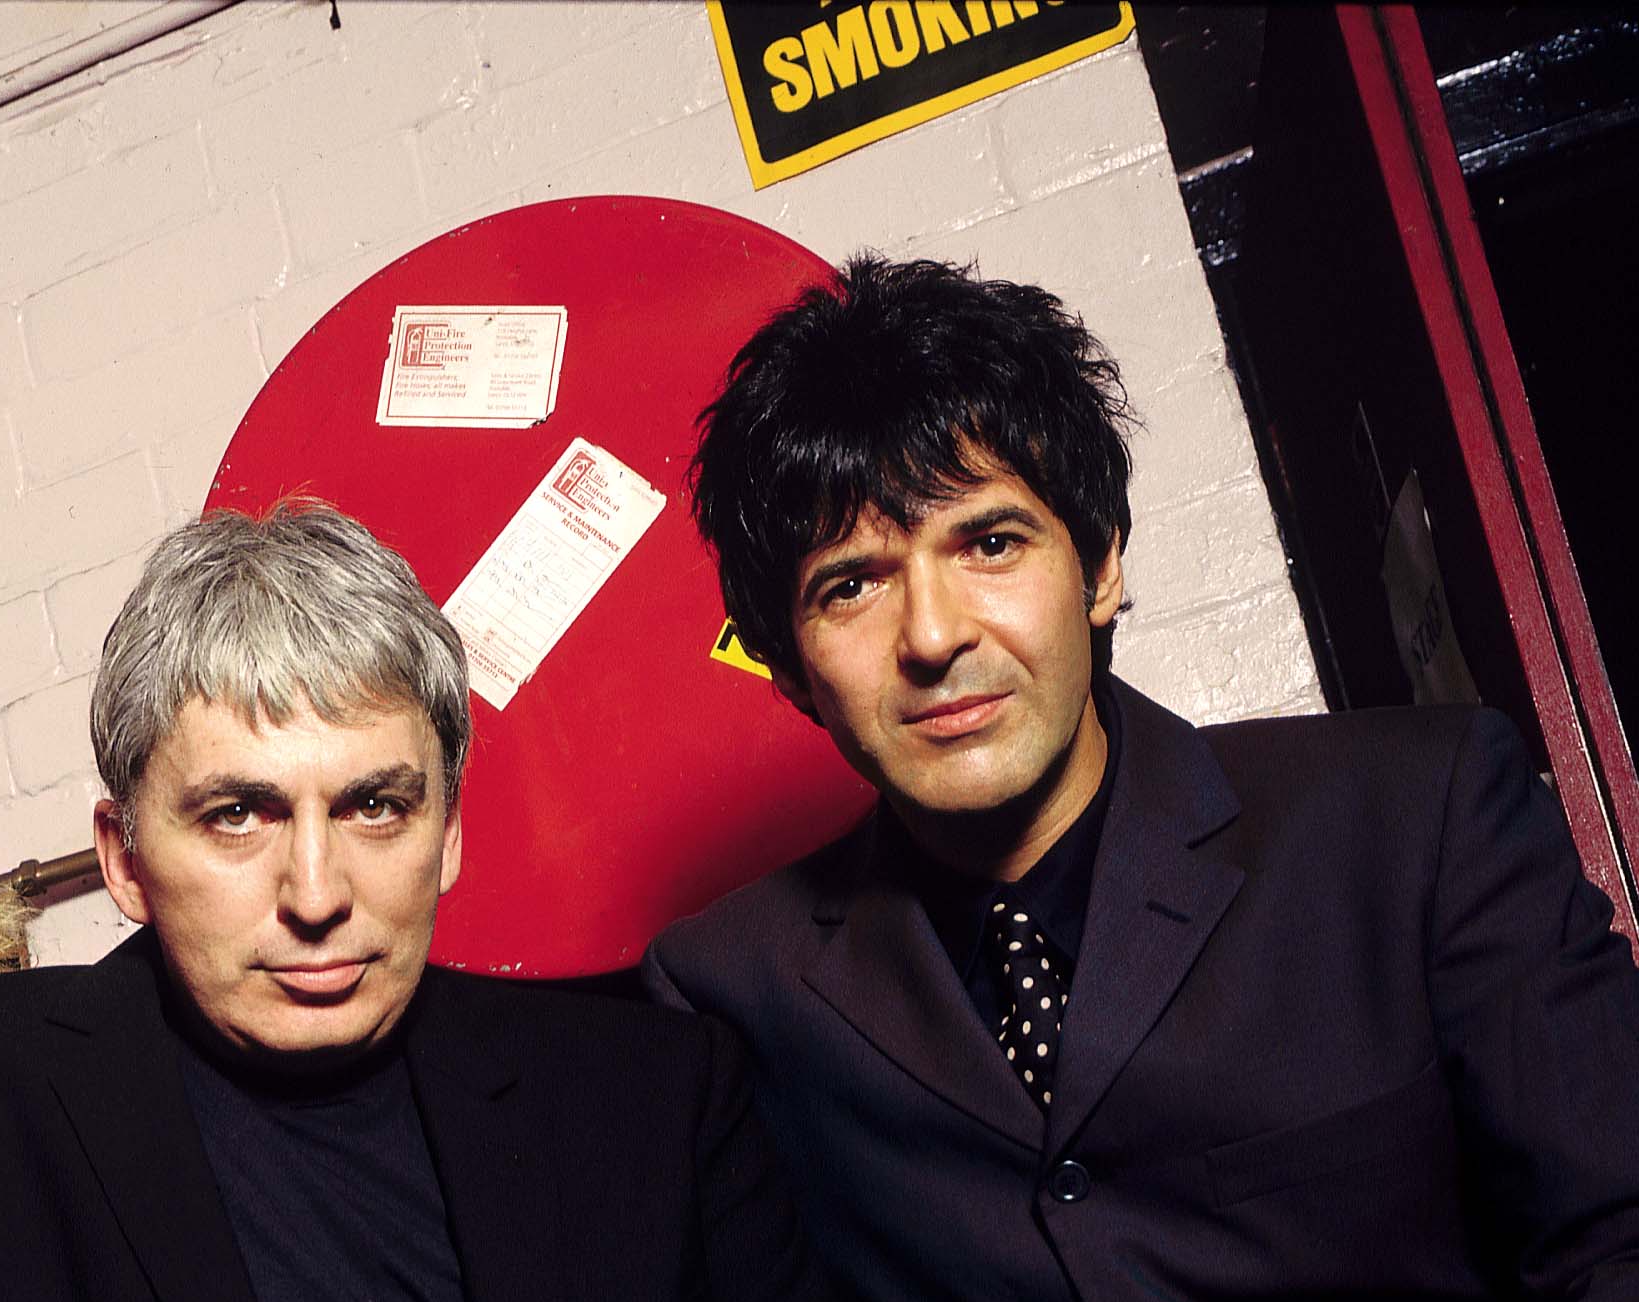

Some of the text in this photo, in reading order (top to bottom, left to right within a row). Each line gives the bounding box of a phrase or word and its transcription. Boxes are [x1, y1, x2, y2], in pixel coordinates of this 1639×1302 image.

[762, 0, 1061, 113] SMOKI
[425, 328, 466, 338] Uni-Fire
[422, 352, 469, 362] Engineers
[424, 341, 472, 350] Protection
[572, 488, 610, 520] Engineers
[542, 491, 567, 513] SERVICE
[574, 515, 621, 553] MAINTENANCE
[561, 517, 589, 541] RECORD
